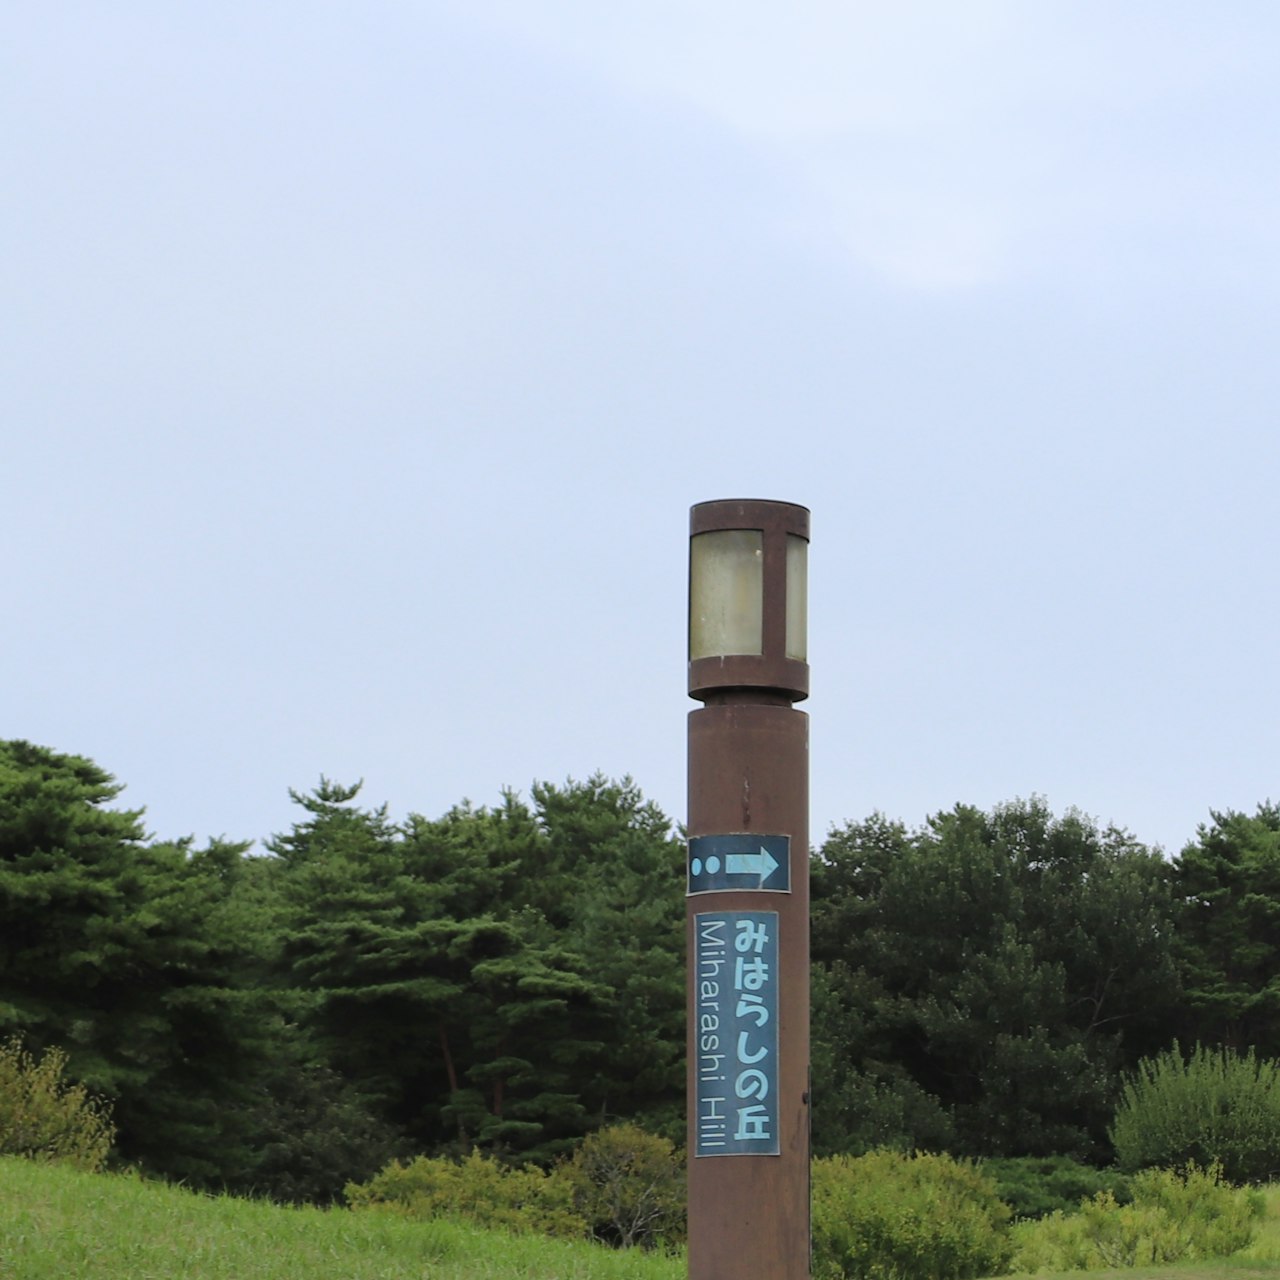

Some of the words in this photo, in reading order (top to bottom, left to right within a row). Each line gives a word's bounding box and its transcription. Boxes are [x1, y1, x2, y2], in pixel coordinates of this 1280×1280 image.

[700, 920, 726, 1081] Miharashi
[733, 918, 770, 1141] みはらしの丘
[700, 1096, 726, 1147] Hill
